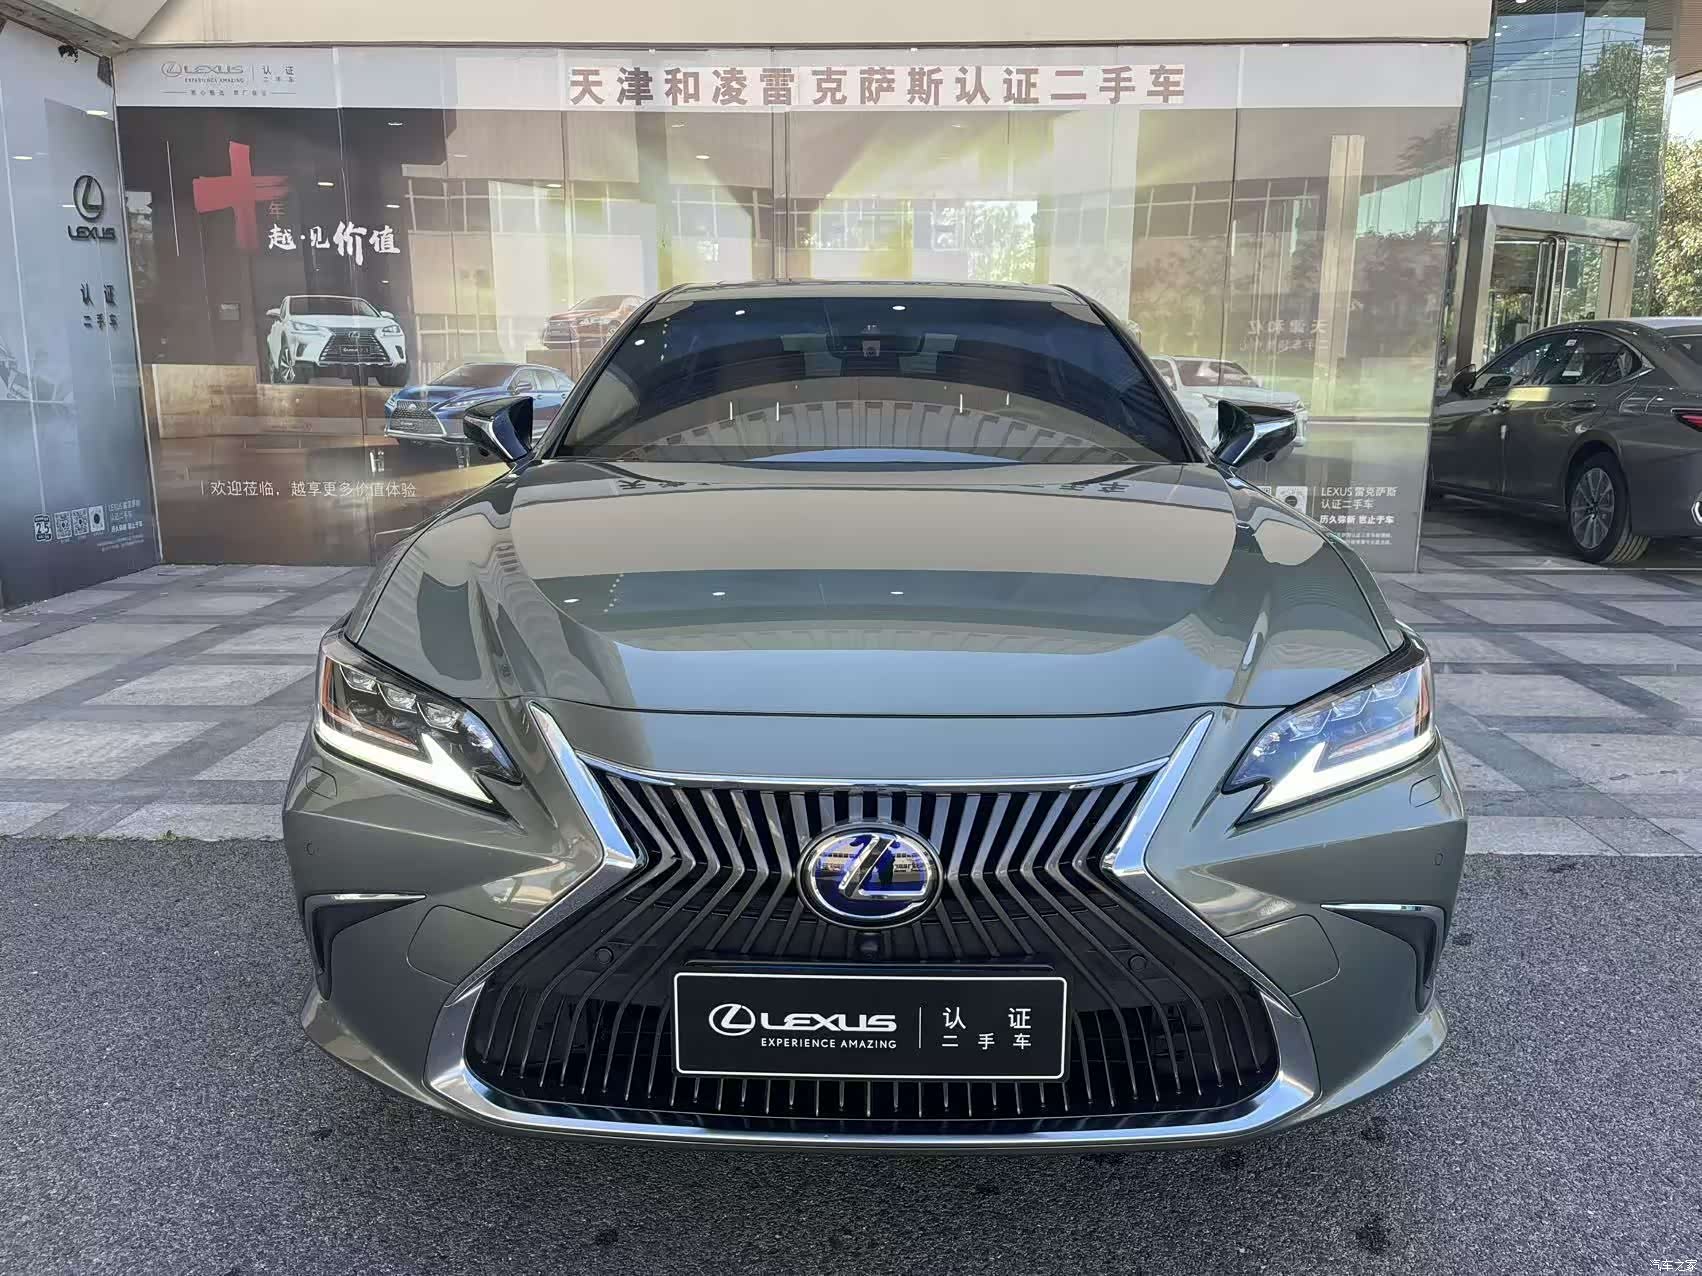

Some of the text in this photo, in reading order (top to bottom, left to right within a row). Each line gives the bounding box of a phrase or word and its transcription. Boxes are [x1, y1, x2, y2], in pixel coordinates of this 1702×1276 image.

[184, 64, 244, 74] LEXUS
[569, 66, 1185, 105] 天津和凌雷克萨斯认证二手车
[67, 225, 117, 241] LEXUS
[80, 282, 116, 305] 认证
[1321, 486, 1353, 497] LEXUS
[1321, 499, 1374, 509] 认证二手车
[760, 1012, 897, 1032] LEXUS
[942, 1006, 1032, 1029] 认证
[761, 1038, 897, 1050] EXPERIENCE AMAZING
[941, 1033, 1032, 1050] 二手车
